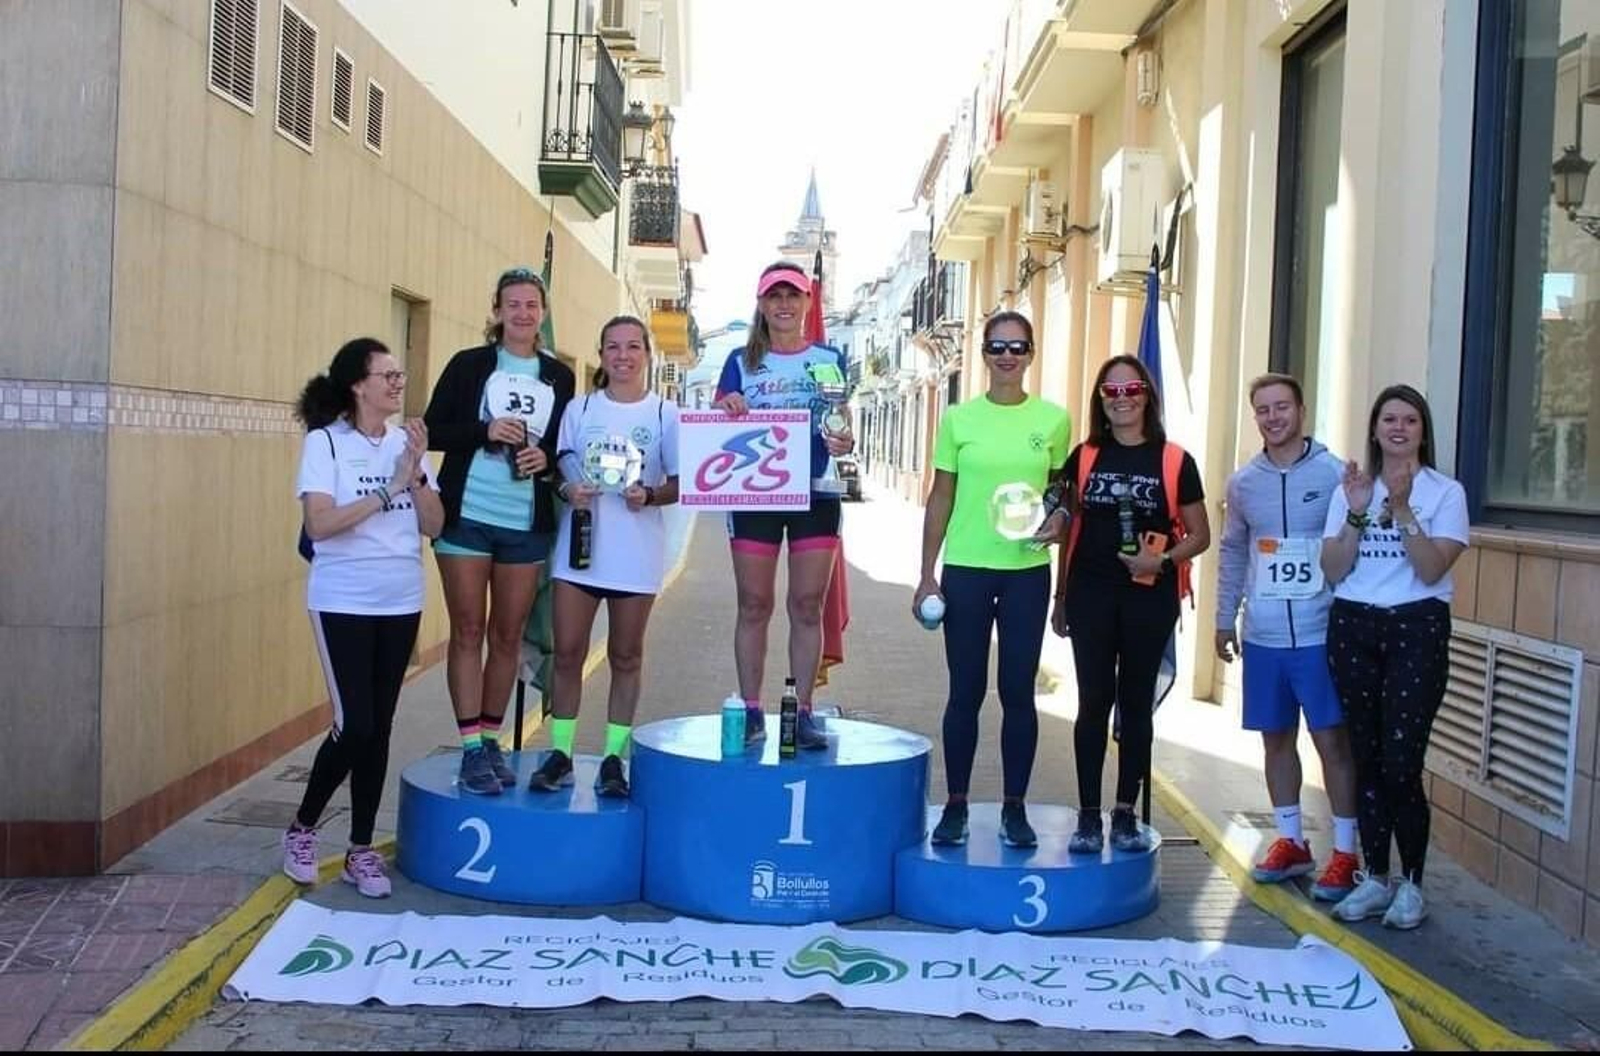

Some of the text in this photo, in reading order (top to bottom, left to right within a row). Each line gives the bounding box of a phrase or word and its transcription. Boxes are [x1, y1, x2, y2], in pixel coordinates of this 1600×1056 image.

[1268, 562, 1312, 583] 195
[779, 780, 812, 845] 1
[455, 817, 496, 884] 2
[777, 876, 830, 889] Bollullos
[1013, 875, 1048, 927] 3
[505, 932, 680, 945] RECICLAJES
[364, 940, 512, 970] DIAZ
[413, 975, 517, 987] Gestor
[548, 976, 584, 987] de
[921, 957, 1377, 1010] DIAZ SANCHEZ
[977, 987, 1078, 1008] Gestor
[1108, 1000, 1144, 1012] de
